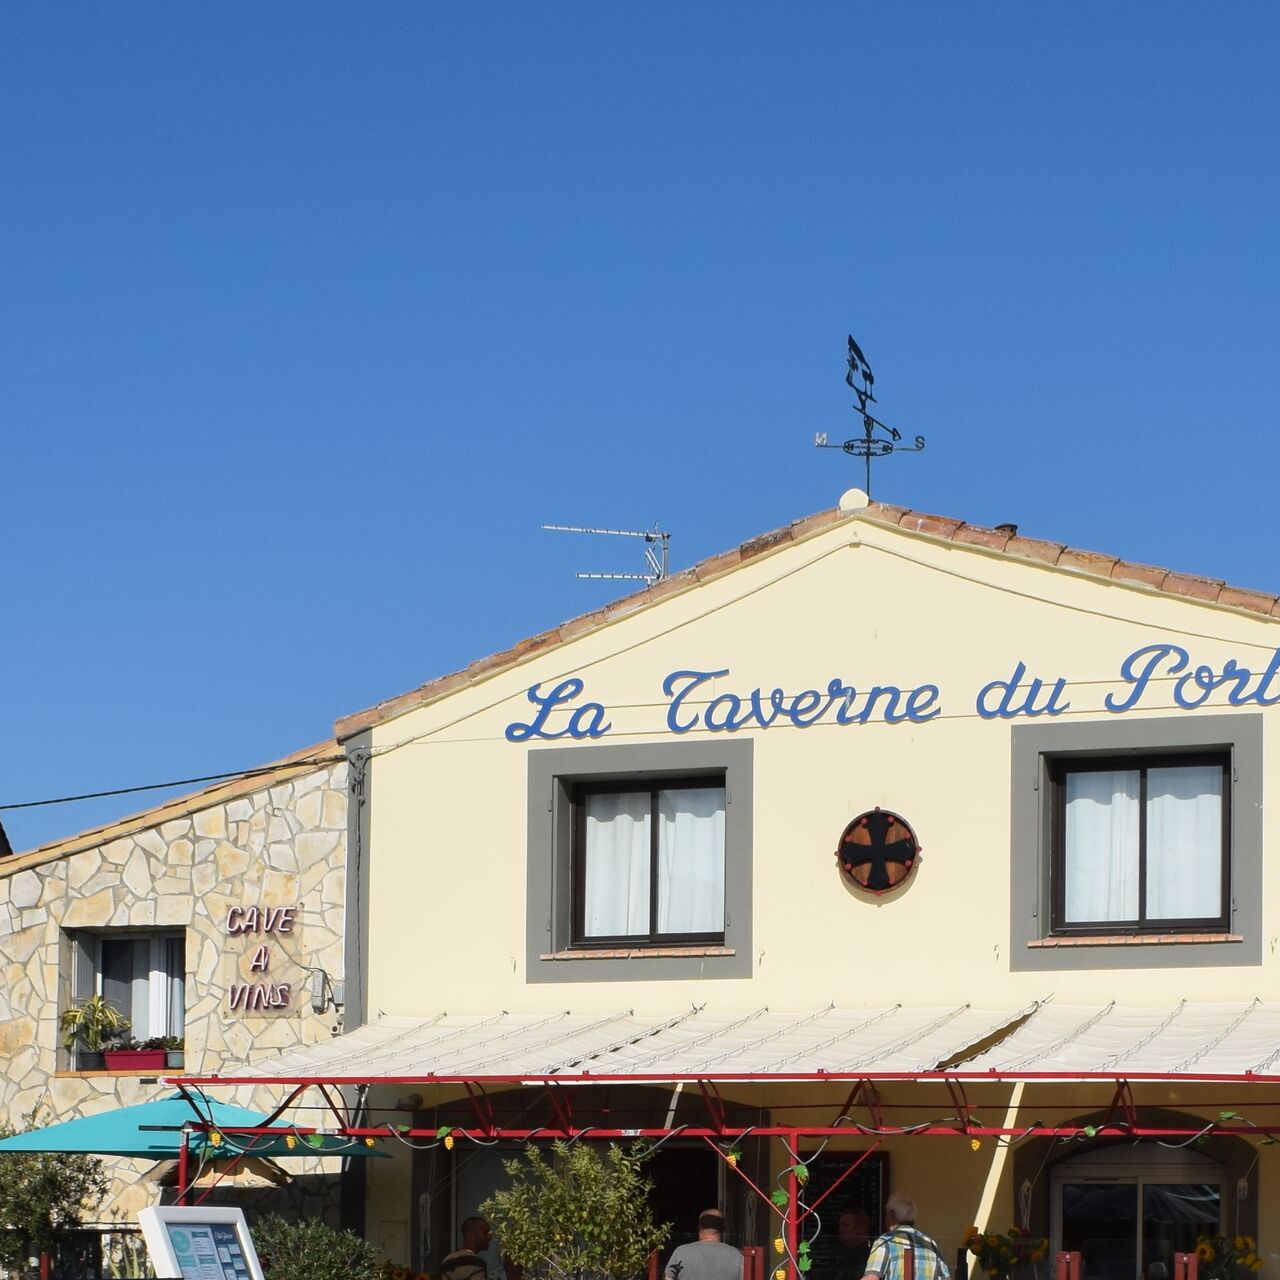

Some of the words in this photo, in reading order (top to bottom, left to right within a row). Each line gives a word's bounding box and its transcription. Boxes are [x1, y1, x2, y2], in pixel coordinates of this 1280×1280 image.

[504, 676, 613, 743] La
[662, 668, 941, 735] Taverne
[976, 661, 1071, 719] du
[226, 905, 298, 935] CAVE
[250, 945, 269, 973] A
[228, 983, 291, 1011] VINS
